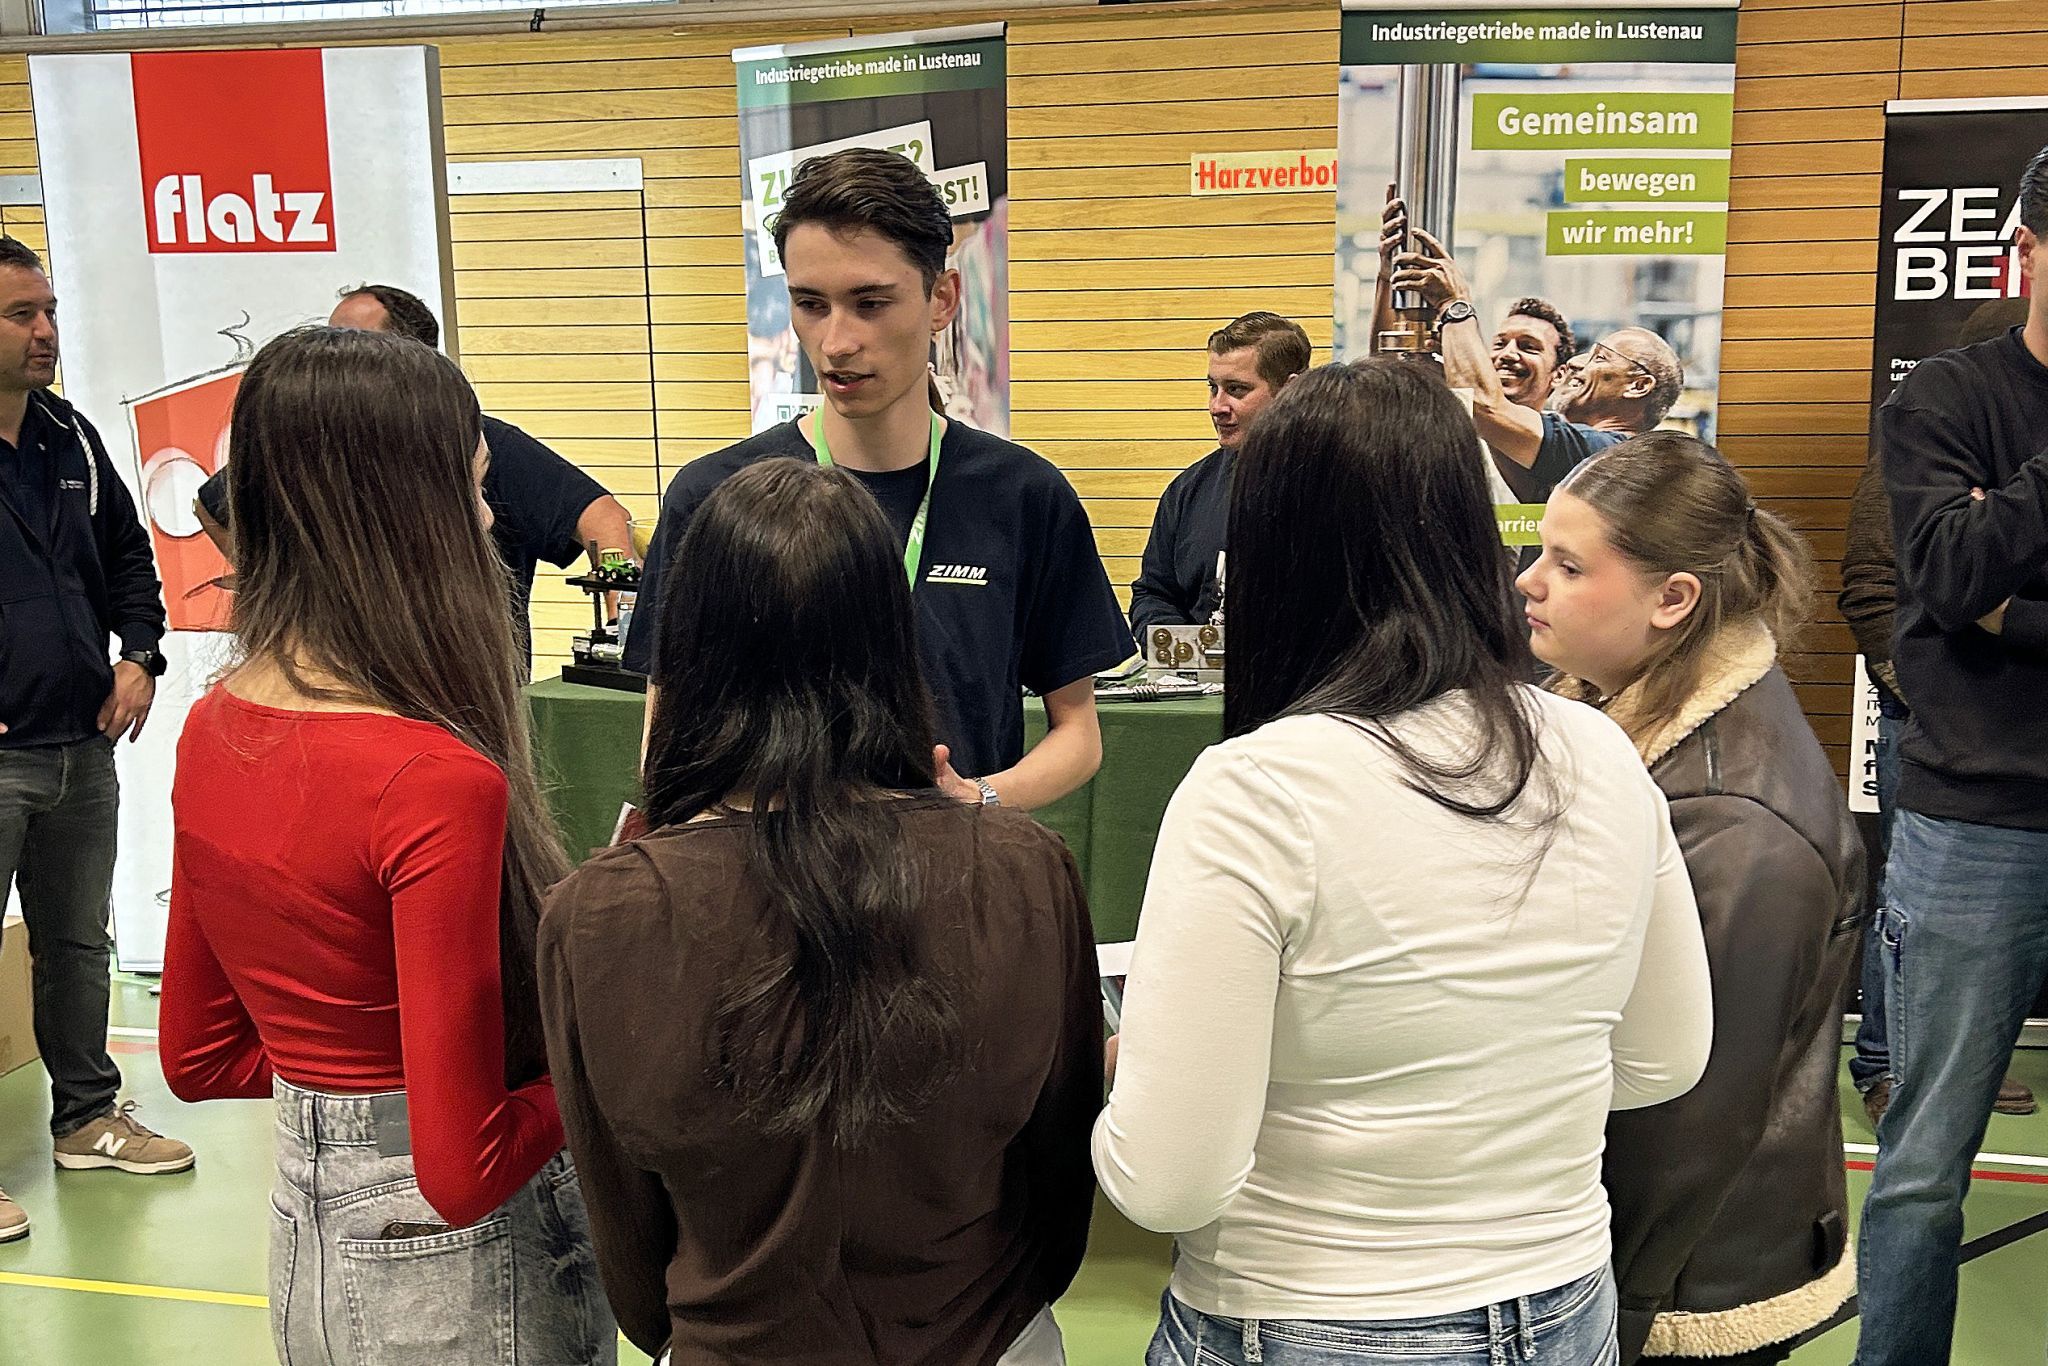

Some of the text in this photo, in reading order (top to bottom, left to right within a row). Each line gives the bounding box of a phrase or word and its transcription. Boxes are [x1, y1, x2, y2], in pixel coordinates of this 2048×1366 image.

[1371, 21, 1703, 44] Industriegetriebe made in Lustenau
[755, 51, 982, 85] Industriegetriebe made in Lustenau
[1497, 103, 1698, 135] Gemeinsam
[1580, 167, 1696, 197] bewegen
[154, 173, 328, 244] flatz
[1562, 219, 1694, 244] wir mehr!
[928, 564, 987, 580] ZIMM
[92, 1131, 128, 1157] N
